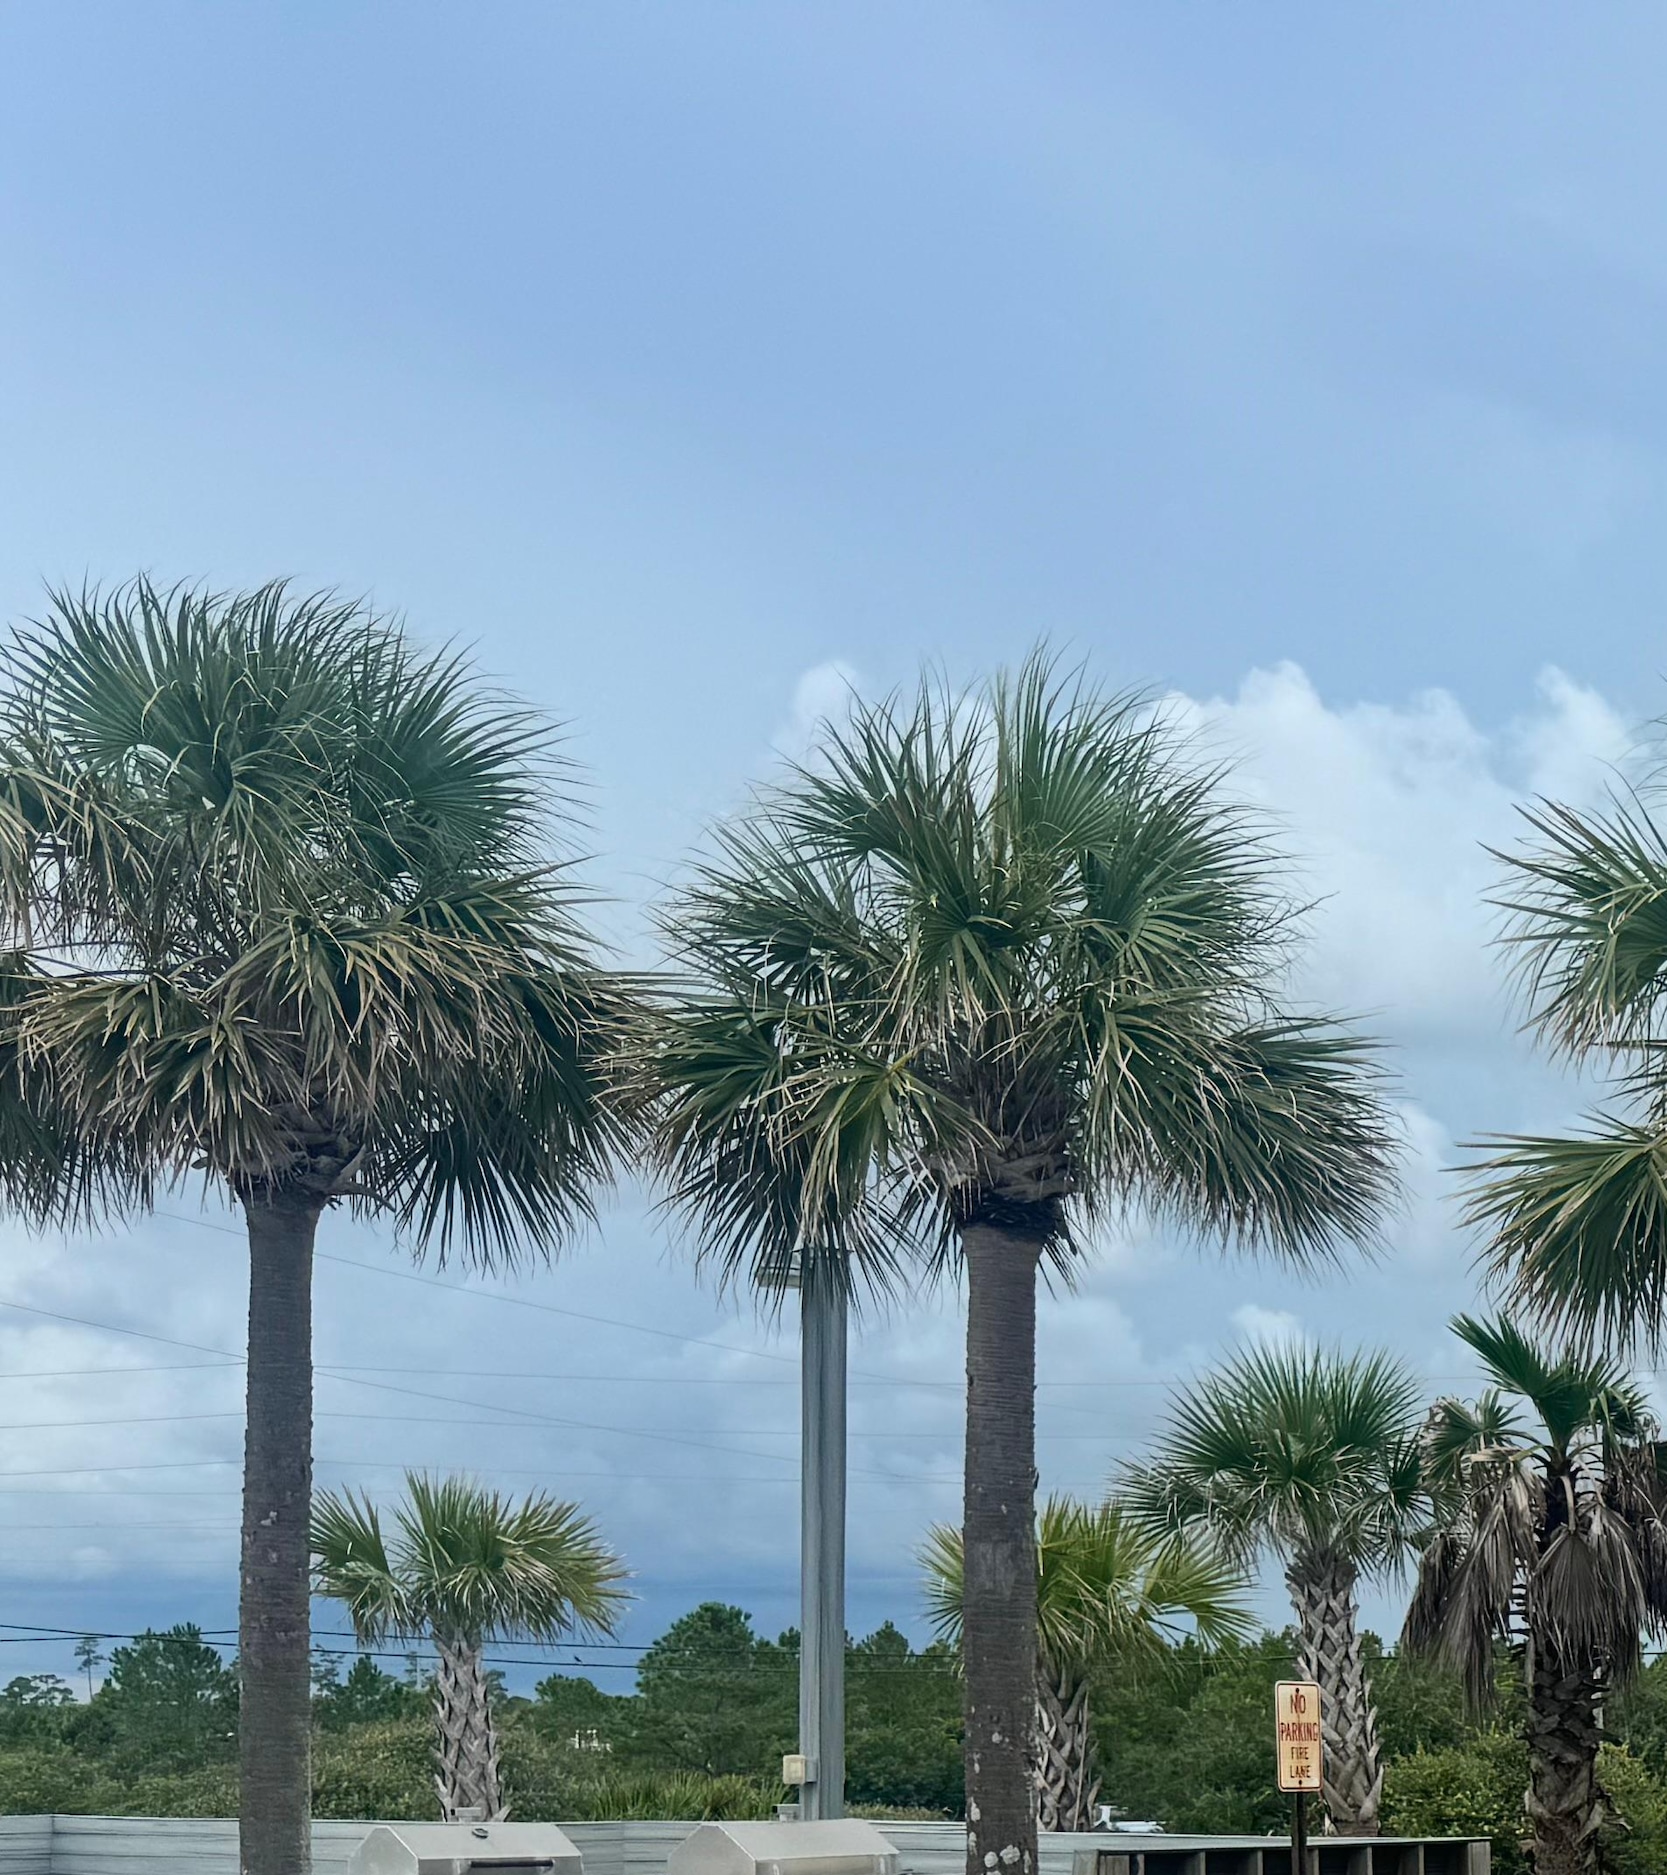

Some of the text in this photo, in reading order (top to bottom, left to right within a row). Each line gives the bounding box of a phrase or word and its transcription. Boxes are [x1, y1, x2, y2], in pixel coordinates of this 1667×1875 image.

[1290, 1694, 1306, 1714] NO
[1280, 1722, 1319, 1742] PARKING
[1290, 1746, 1309, 1760] FIRE
[1289, 1765, 1311, 1779] LANE
